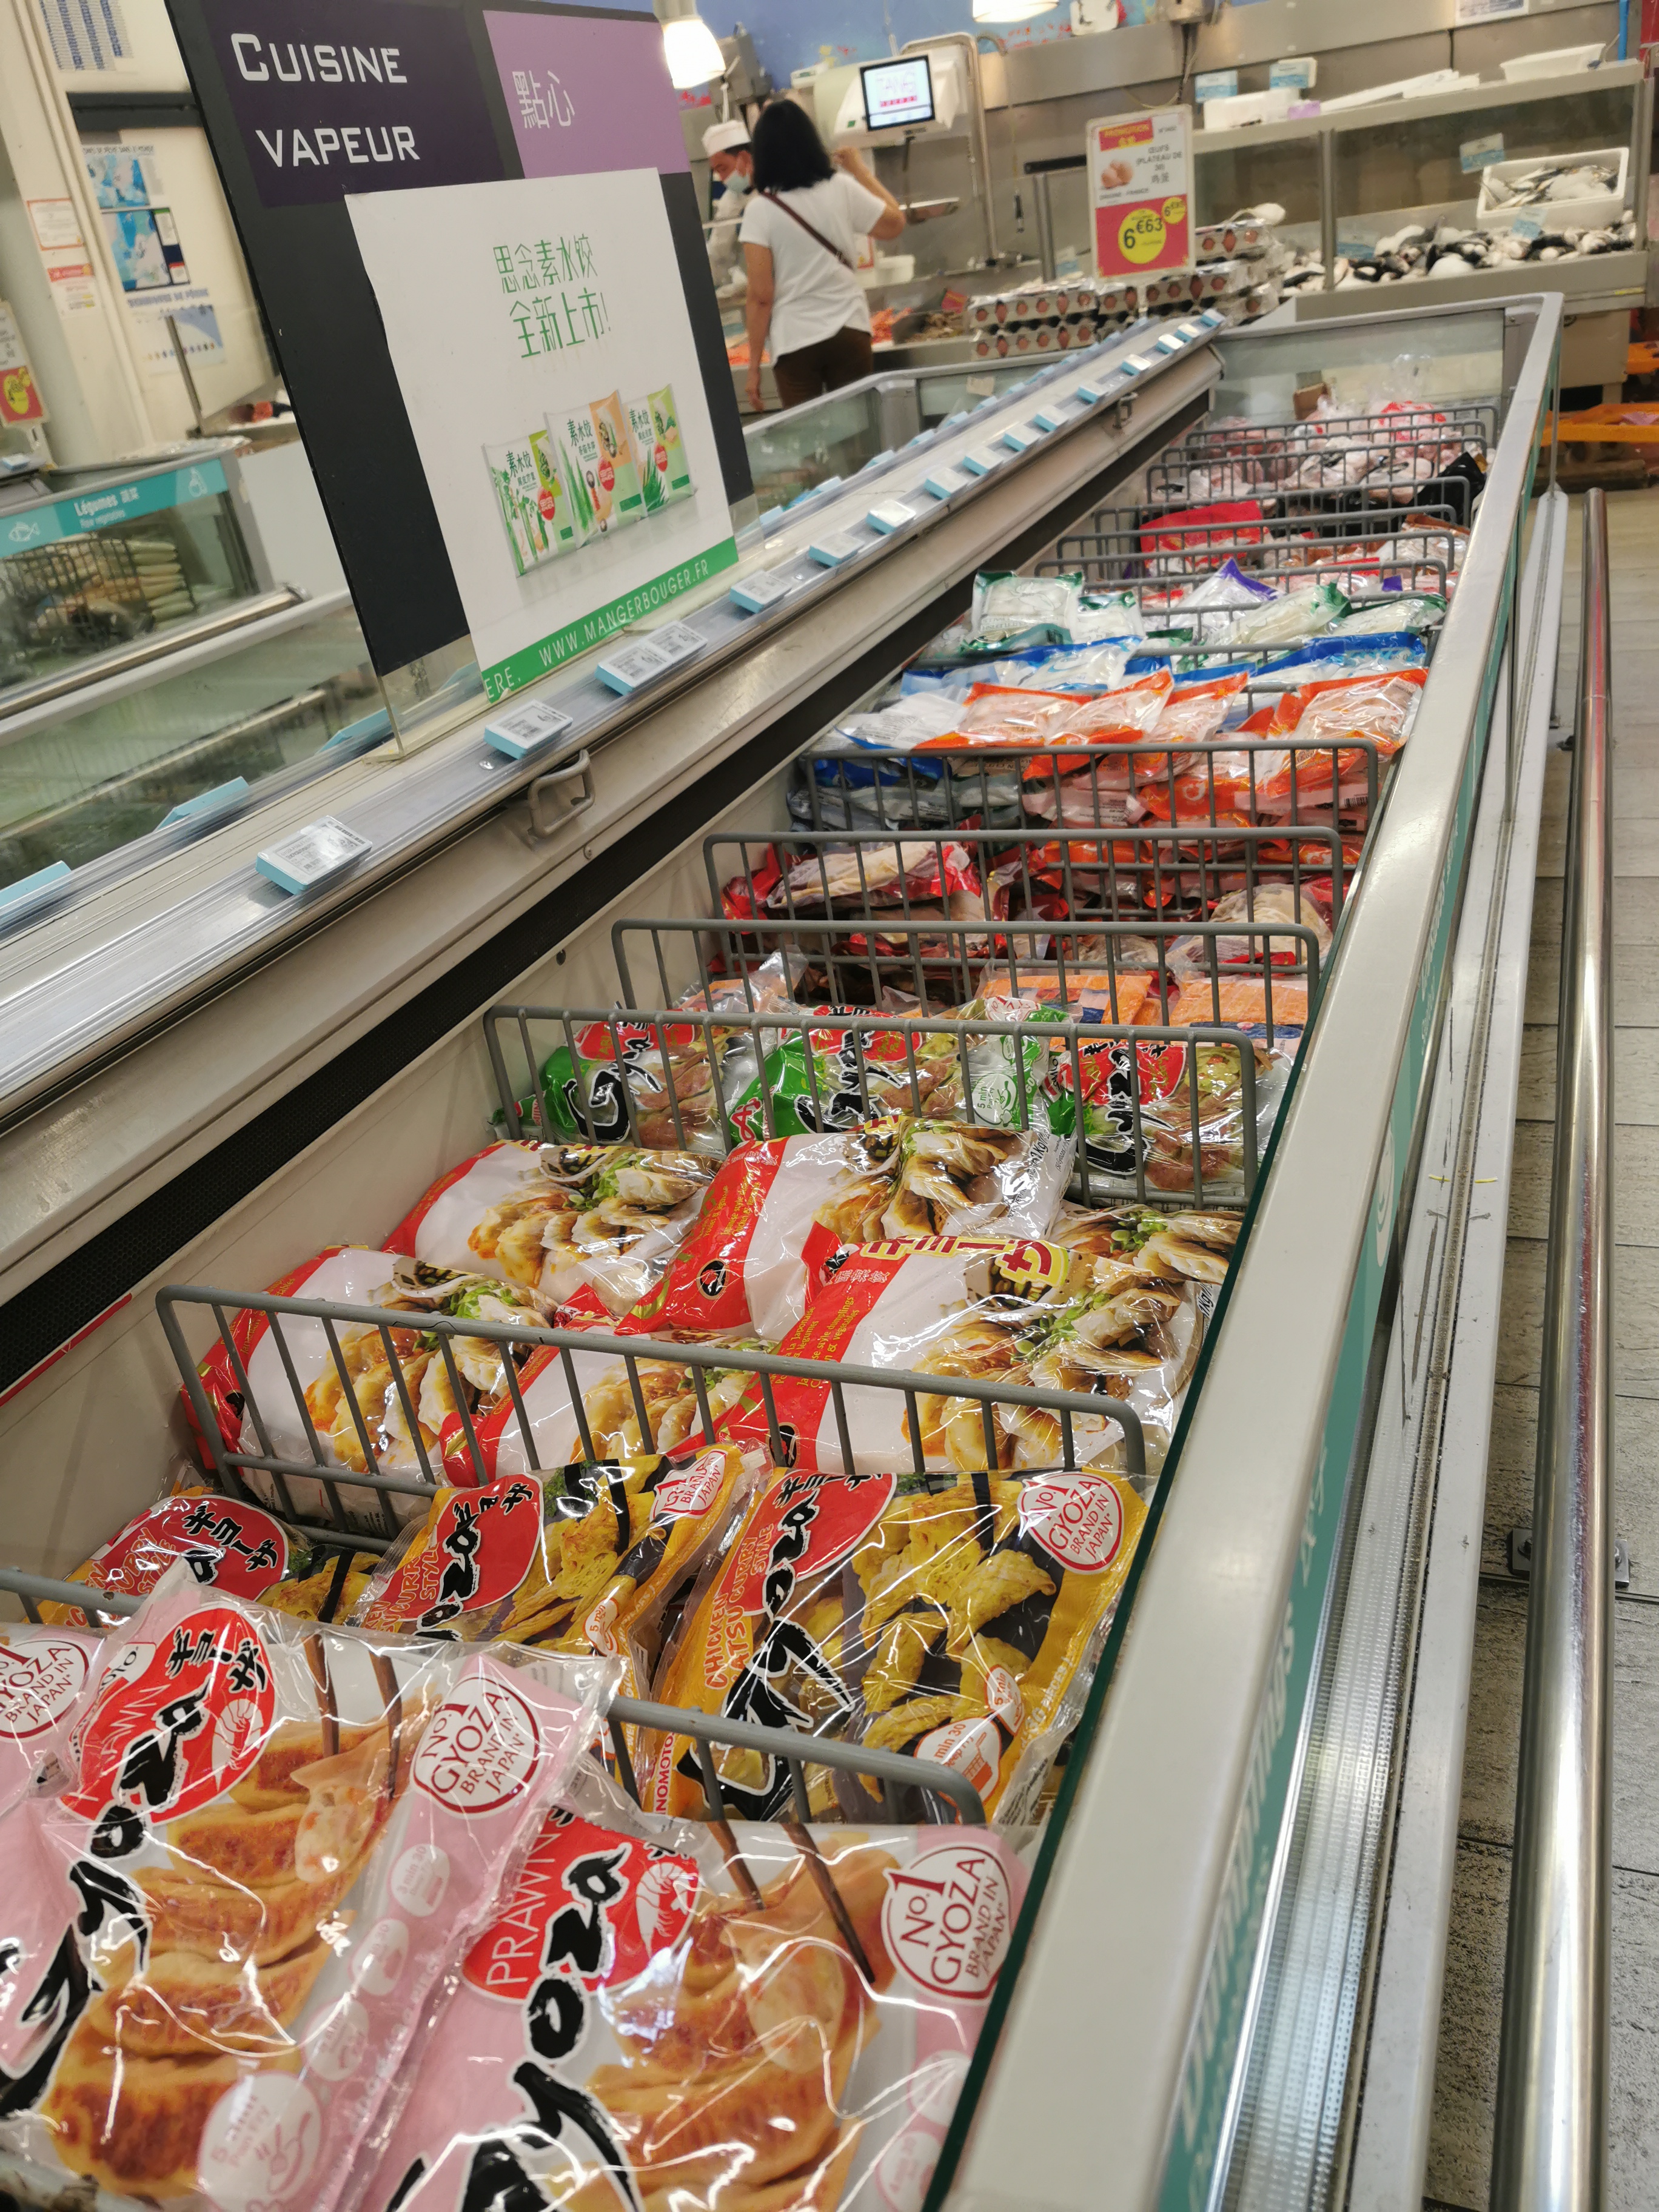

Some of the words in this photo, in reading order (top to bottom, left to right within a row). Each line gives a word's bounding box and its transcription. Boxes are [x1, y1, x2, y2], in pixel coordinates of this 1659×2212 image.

[231, 33, 407, 82] CUISINE
[512, 70, 574, 129] 點心
[255, 126, 420, 167] VAPEUR
[493, 234, 598, 294] 思念素水饺
[510, 287, 611, 358] 全新上市!
[567, 418, 593, 447] 素水饺
[539, 559, 709, 667] WWW.MANGERBOUGER.FR
[791, 1306, 816, 1341] Japonaise
[817, 1329, 831, 1349] style
[826, 1296, 854, 1330] dumplings
[833, 1310, 859, 1340] vegetables
[183, 1501, 277, 1572] ギョーザ
[1049, 1481, 1102, 1550] GYOZA
[1070, 1510, 1099, 1555] BRAND
[1095, 1493, 1110, 1512] IN
[729, 1537, 757, 1603] CURRY
[750, 1523, 774, 1576] STYLE
[389, 1556, 421, 1612] CURR
[54, 1658, 74, 1674] IN
[164, 1626, 266, 1692] ギョーザ
[705, 1592, 728, 1689] CHICKEN
[726, 1606, 750, 1684] ATSU
[0, 1647, 73, 1715] YOZA
[431, 1692, 510, 1794] GYOZA
[459, 1732, 504, 1795] BRAND
[499, 1711, 518, 1732] IN
[948, 1723, 967, 1737] 30
[487, 1831, 562, 1986] PRAWN
[930, 1858, 986, 1985] GYOZA
[965, 1905, 991, 1979] BRAND
[982, 1877, 999, 1902] IN
